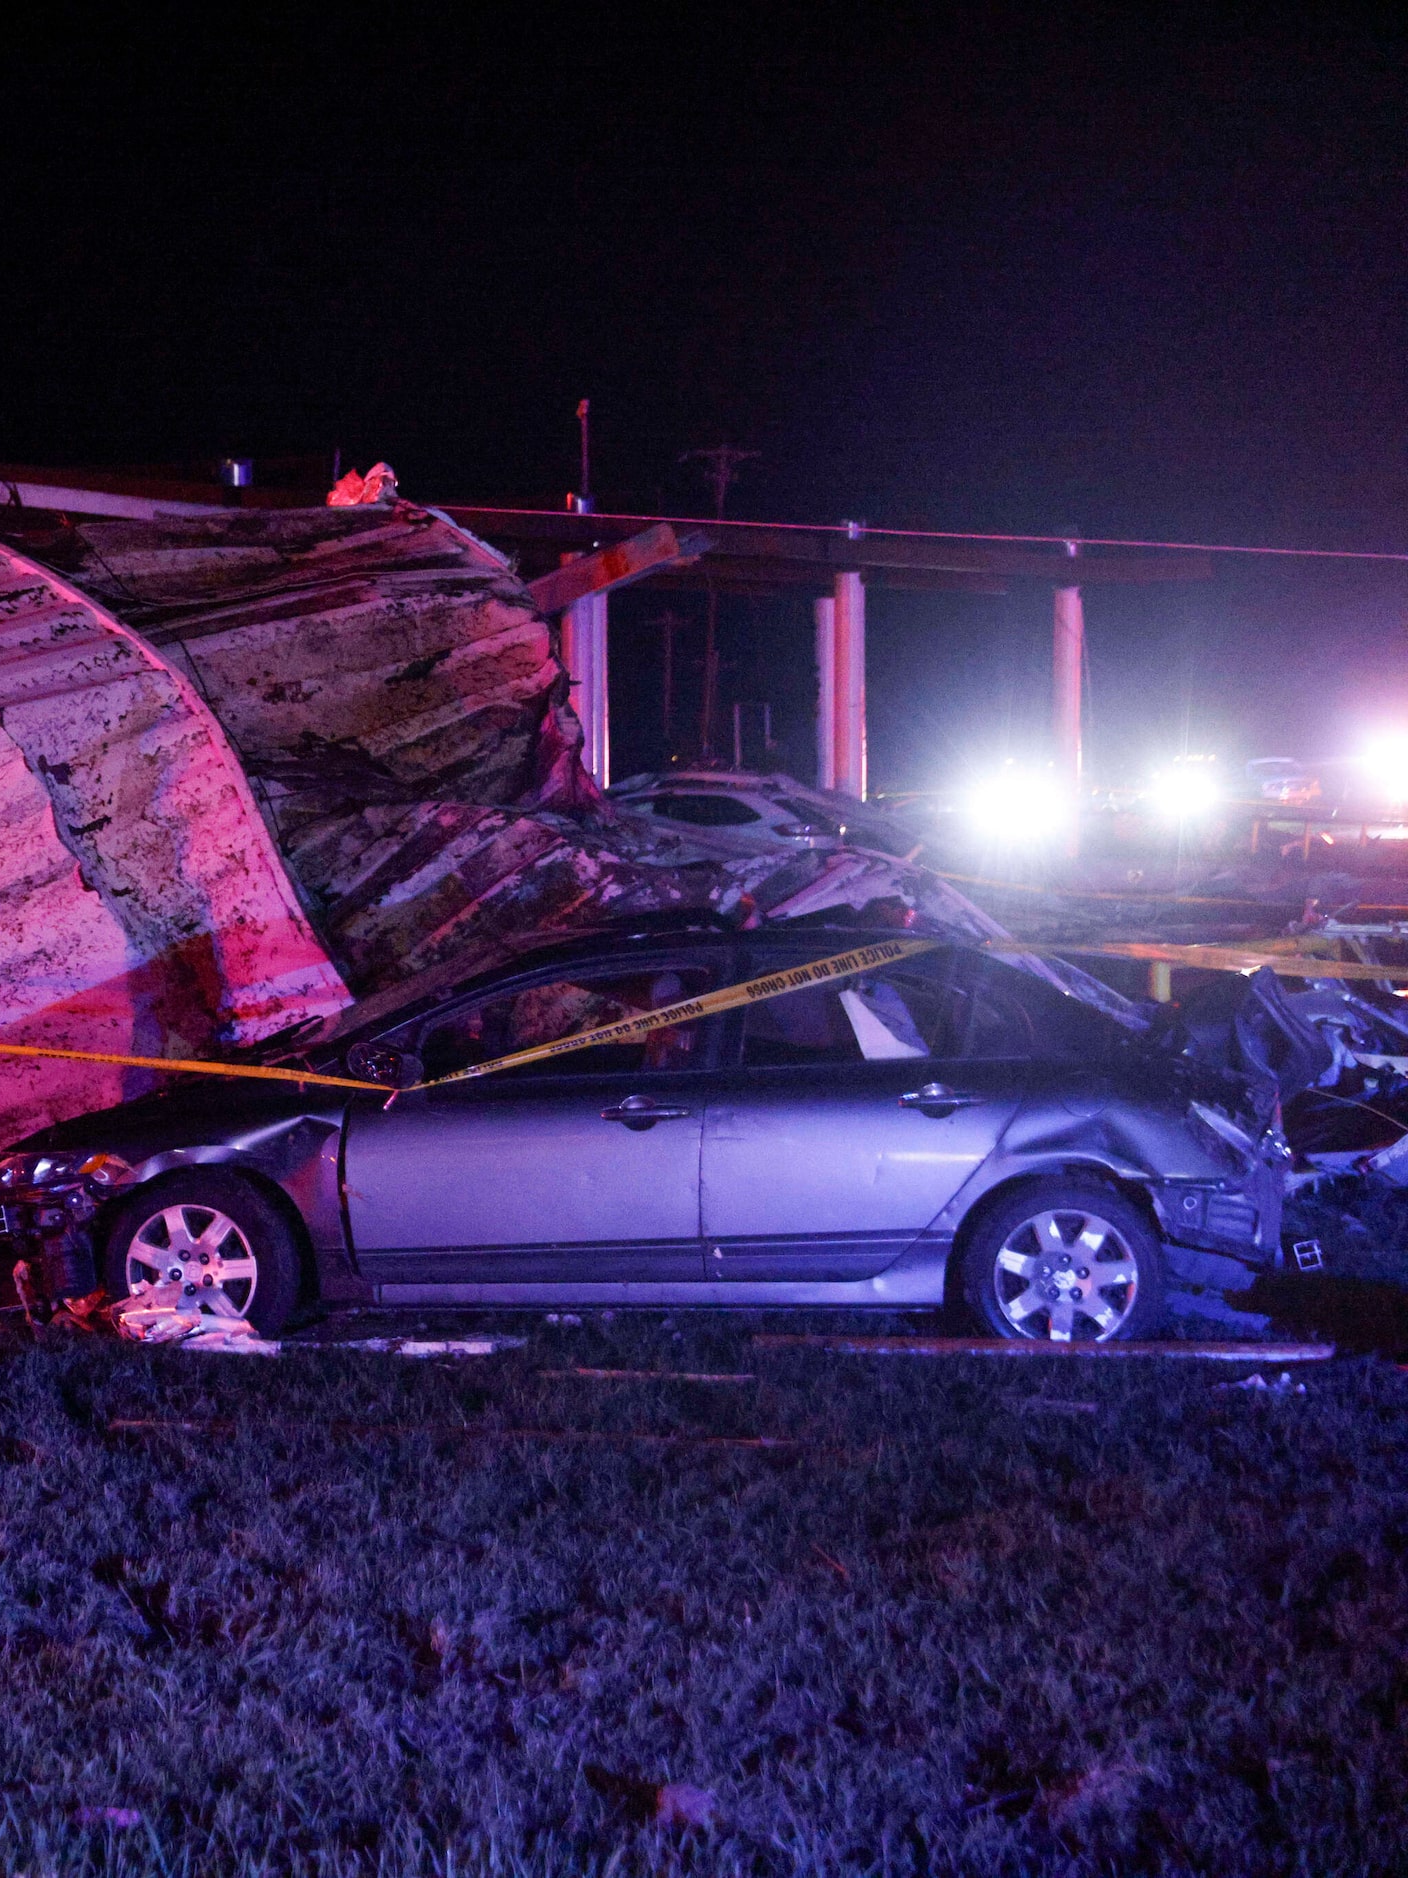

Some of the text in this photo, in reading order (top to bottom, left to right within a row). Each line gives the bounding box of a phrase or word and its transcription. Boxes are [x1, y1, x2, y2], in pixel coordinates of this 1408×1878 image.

[746, 942, 902, 998] POLICE LINE DO NOT CROSS
